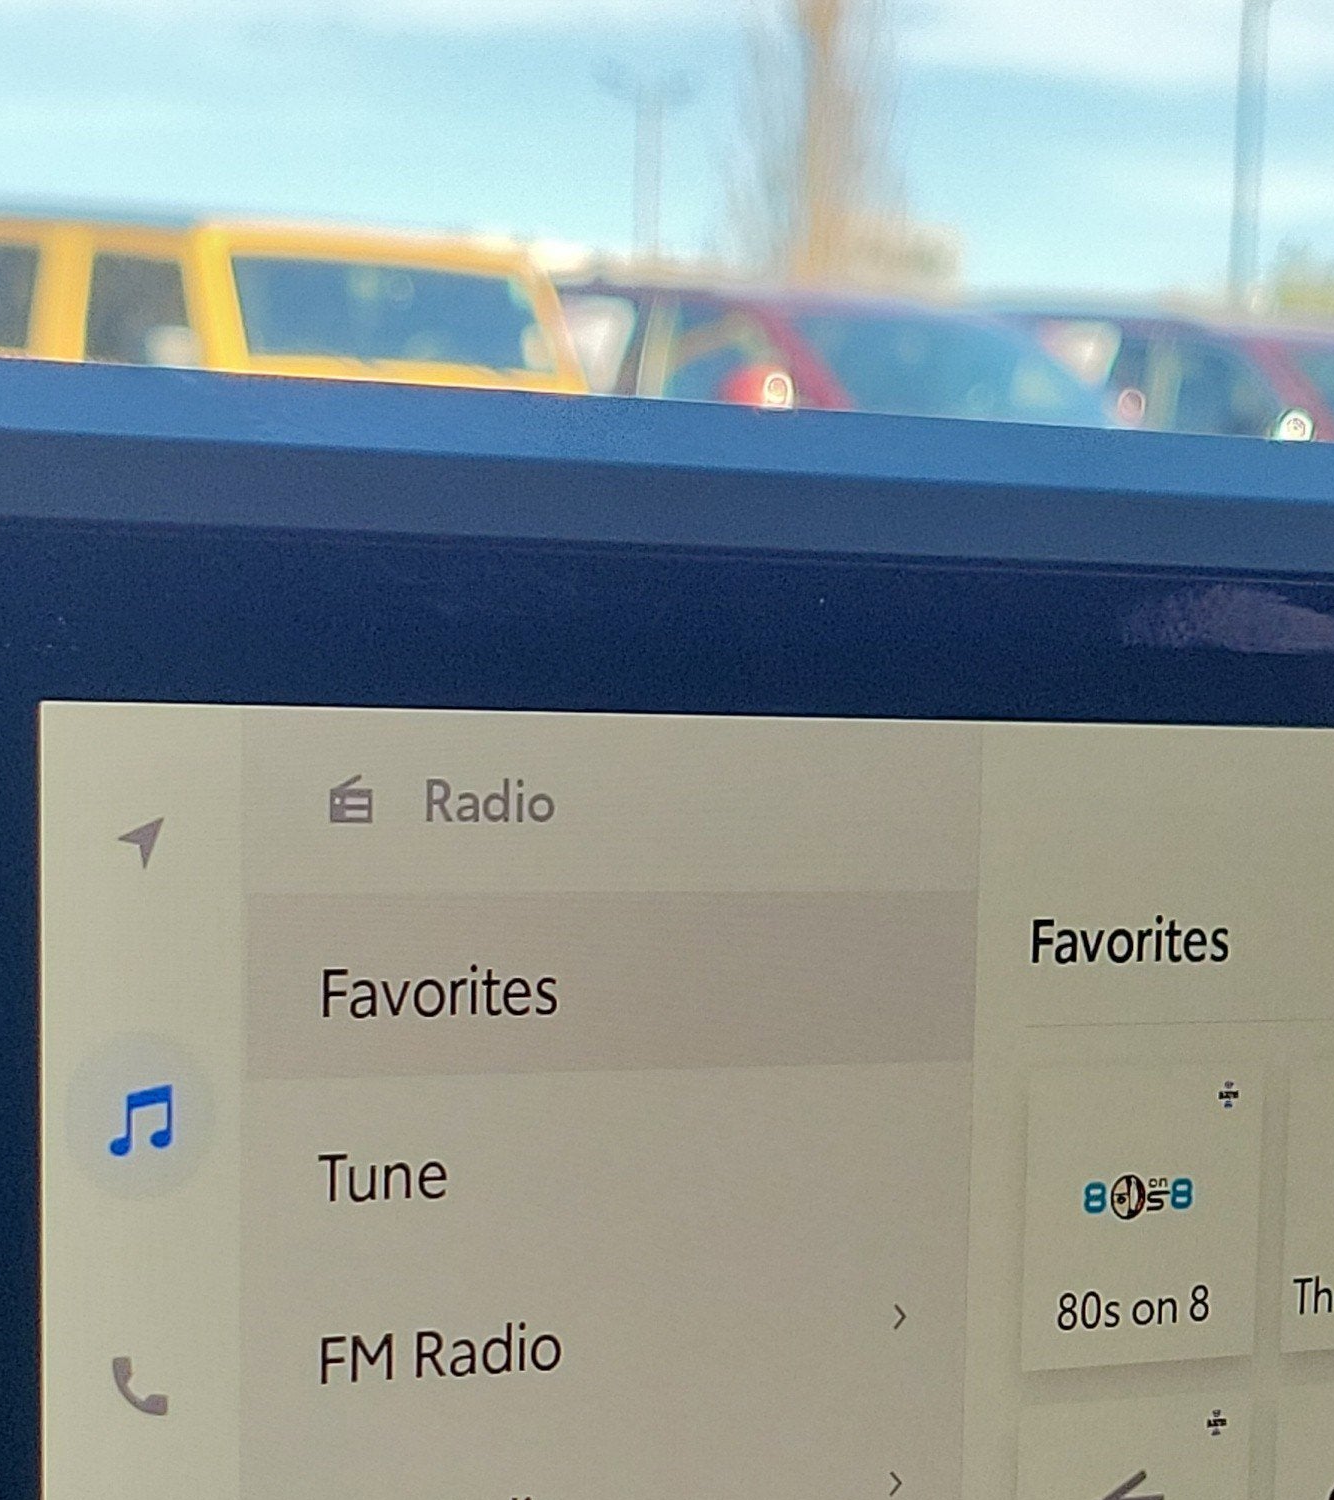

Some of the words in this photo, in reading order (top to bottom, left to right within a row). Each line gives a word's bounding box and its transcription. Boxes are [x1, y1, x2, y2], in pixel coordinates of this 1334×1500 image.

[424, 779, 556, 825] Radio
[1029, 914, 1231, 966] Favorites
[320, 965, 559, 1020] Favorites
[318, 1153, 448, 1203] Tune
[1056, 1290, 1121, 1331] 80s
[1131, 1298, 1180, 1328] on
[1187, 1284, 1211, 1323] 8
[319, 1335, 395, 1385] FM
[414, 1322, 563, 1380] Radio
